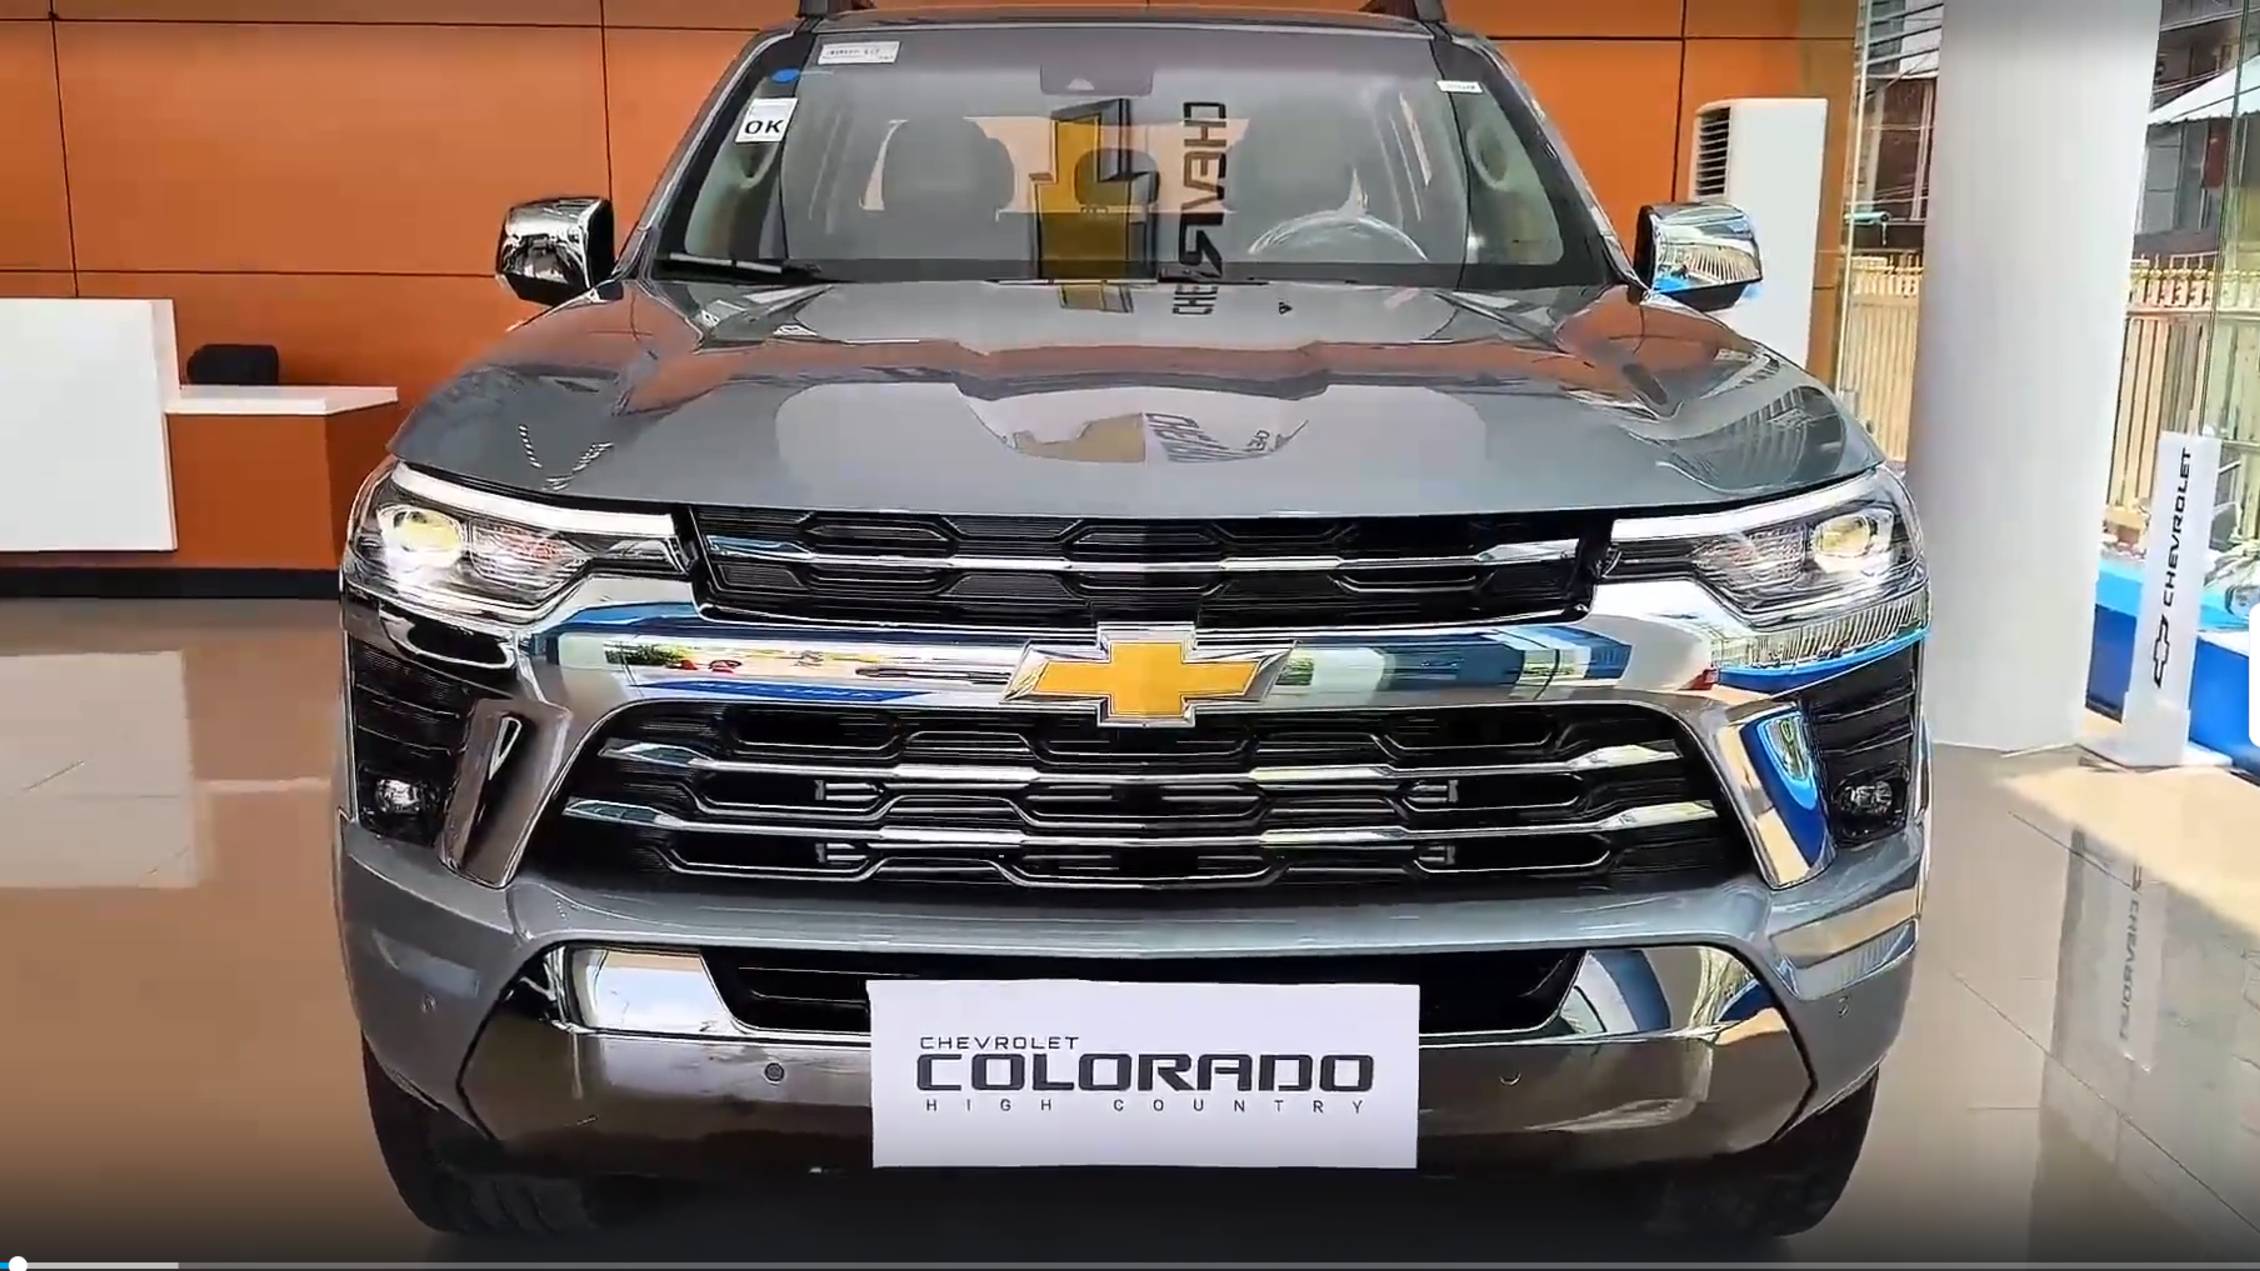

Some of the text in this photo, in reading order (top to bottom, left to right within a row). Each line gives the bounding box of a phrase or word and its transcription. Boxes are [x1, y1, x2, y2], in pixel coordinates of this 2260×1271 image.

[744, 120, 784, 134] OK
[2163, 447, 2191, 607] CHEVROLET
[919, 1036, 1080, 1050] CHEVROLET
[916, 1053, 1375, 1093] COLORADO
[925, 1098, 1364, 1114] HIGH COUNTRY
